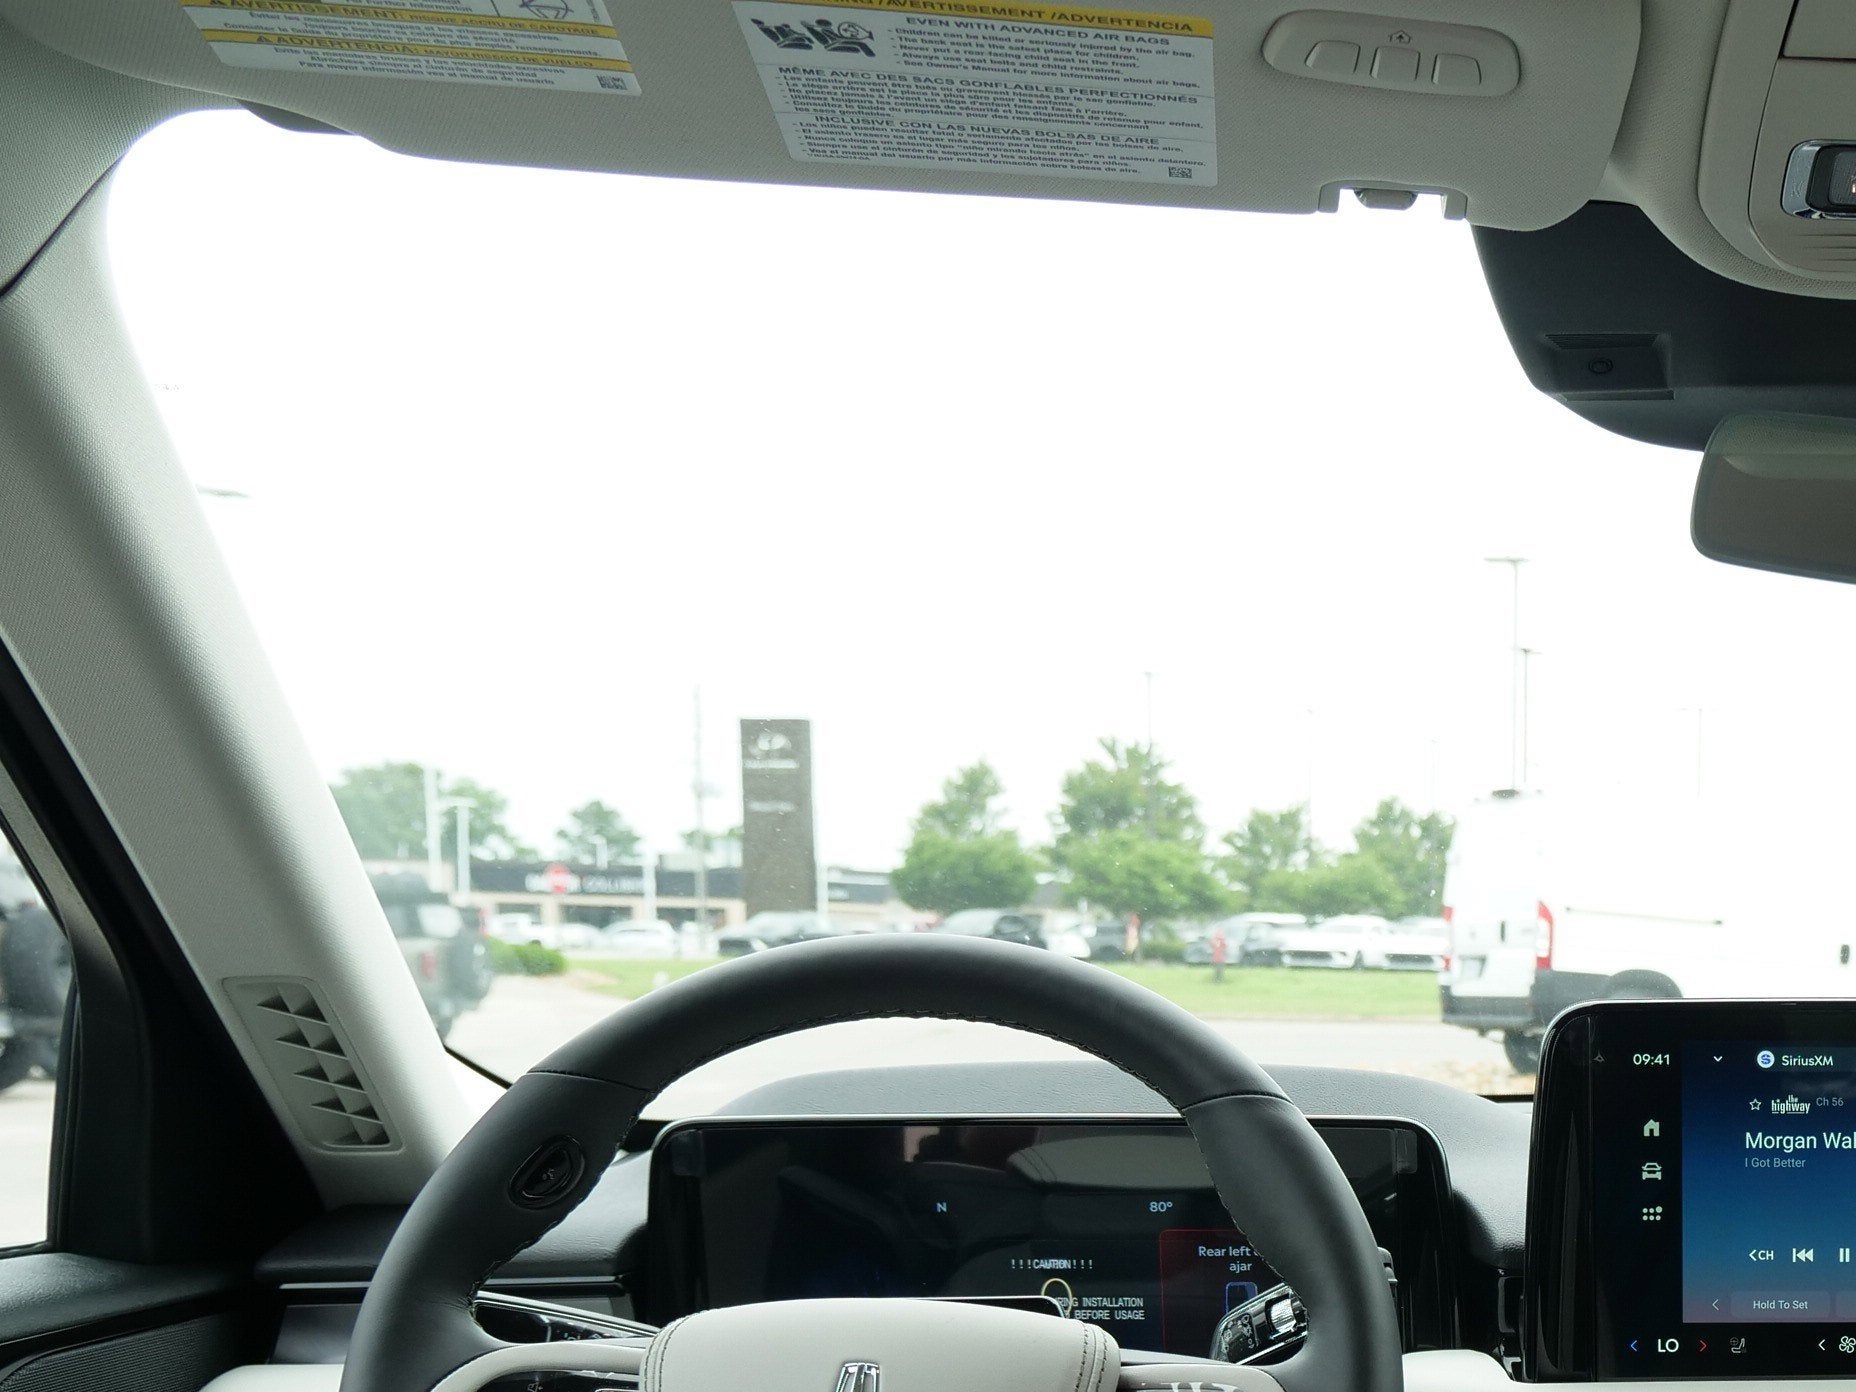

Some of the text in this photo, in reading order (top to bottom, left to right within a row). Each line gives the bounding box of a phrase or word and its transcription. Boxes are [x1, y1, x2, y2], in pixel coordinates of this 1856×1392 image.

[905, 17, 1169, 45] EVEN WITH ADVANCED AIR BAGS
[830, 70, 871, 79] AVEC
[875, 73, 908, 82] DES
[912, 76, 955, 85] SACS
[959, 79, 1064, 93] GONFLABLES
[1068, 87, 1197, 103] PERFECTIONNÉS
[814, 115, 1159, 144] INCLUSIVE CON LAS NUEVAS BOLSAS DE AIRE
[1633, 1053, 1670, 1066] 09:41
[1781, 1055, 1834, 1067] SiriusXM
[1771, 1099, 1811, 1115] highway
[1816, 1097, 1844, 1107] Ch 56
[1745, 1131, 1817, 1153] Morgan
[1751, 1158, 1772, 1168] Got
[1774, 1158, 1806, 1168] Better
[936, 1202, 947, 1212] N
[1150, 1202, 1173, 1212] 80°
[1198, 1245, 1251, 1257] Rear left
[1229, 1262, 1252, 1274] ajar
[1082, 1297, 1144, 1308] INSTALLATION
[1753, 1300, 1808, 1310] Hold To Set
[1074, 1310, 1145, 1320] BEFORE USAGE
[1658, 1339, 1679, 1353] LO
